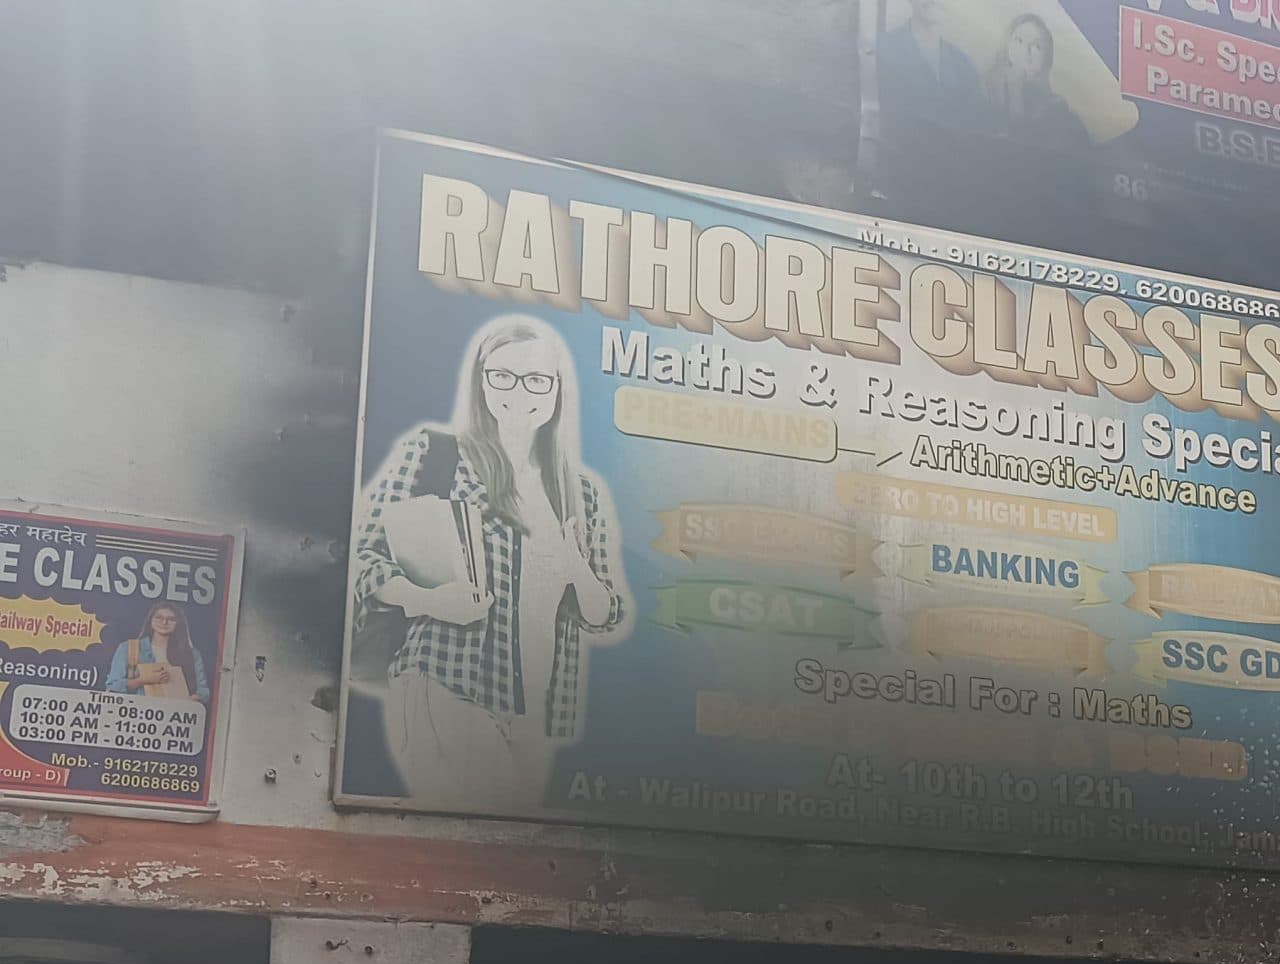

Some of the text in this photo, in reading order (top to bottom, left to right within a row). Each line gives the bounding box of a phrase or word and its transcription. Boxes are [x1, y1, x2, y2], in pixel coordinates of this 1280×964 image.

[1132, 17, 1205, 64] I.Sc.
[417, 174, 895, 356] RATHORE
[601, 326, 777, 400] Maths
[800, 362, 839, 409] &
[859, 374, 1125, 464] Reasoning
[910, 434, 1258, 514] Arithmetic+Advance
[927, 491, 960, 514] TO
[967, 498, 1027, 529] HIGH
[1033, 506, 1105, 537] LEVEL
[26, 526, 88, 546] महादेव
[34, 547, 217, 604] CLASSES
[932, 544, 1080, 589] BANKING
[0, 611, 93, 638] ailway Special
[708, 587, 823, 629] CSAT
[1163, 639, 1228, 674] SSC
[23, 697, 68, 712] 07:00
[74, 701, 101, 716] AM
[118, 706, 164, 722] 08:00
[169, 711, 197, 725] AM
[90, 691, 124, 706] Time
[794, 657, 1193, 730] Special For : Maths
[18, 726, 66, 741] 03:00
[71, 730, 98, 744] PM
[115, 734, 161, 750] 04:00
[167, 739, 193, 753] PM
[20, 712, 65, 727] 10:00
[70, 716, 99, 730] AM
[115, 720, 157, 735] 11:00
[162, 725, 190, 739] AM
[101, 773, 200, 793] 6200686869
[104, 757, 198, 777] 9162178229
[900, 759, 987, 800] 10th
[1000, 768, 1040, 804] to
[1053, 772, 1135, 809] 12th
[568, 768, 608, 802] At
[639, 775, 767, 817] Walipur
